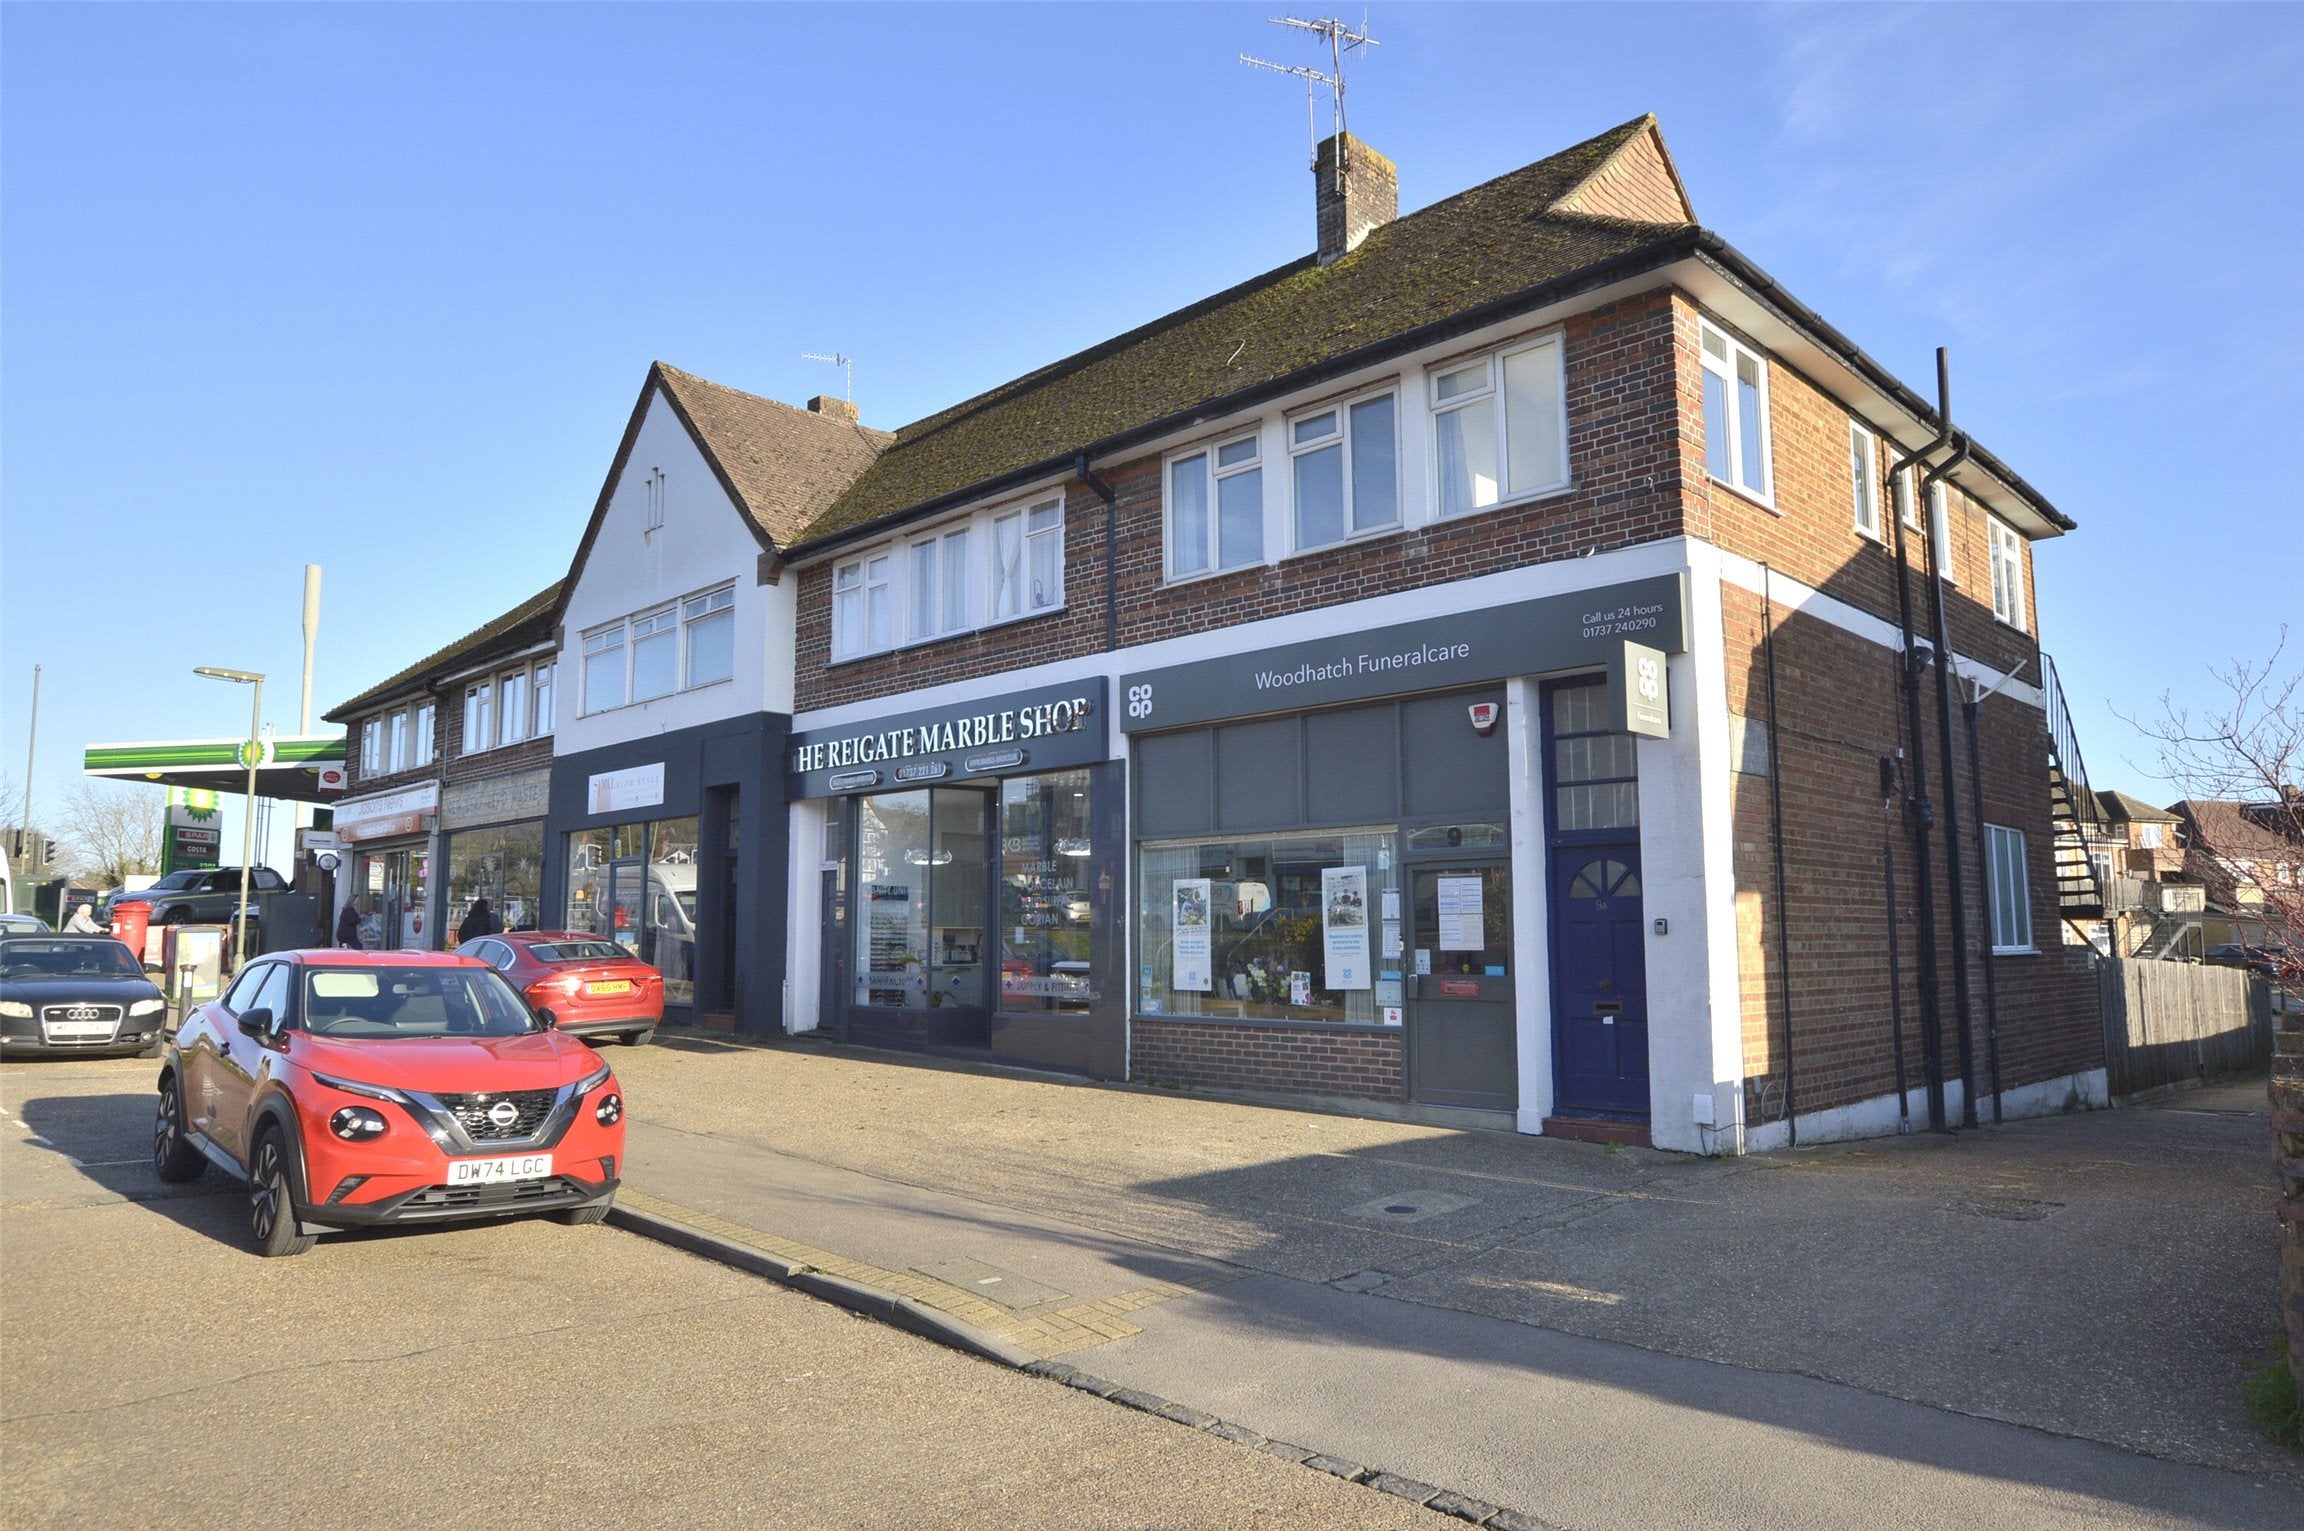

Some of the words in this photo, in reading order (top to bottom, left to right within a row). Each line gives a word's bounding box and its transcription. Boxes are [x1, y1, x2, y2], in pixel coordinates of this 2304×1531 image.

[1582, 612, 1601, 624] Call
[1604, 611, 1615, 621] us
[1618, 607, 1630, 619] 24
[1634, 604, 1663, 616] hours
[1583, 624, 1612, 639] 01737
[1615, 617, 1656, 634] 240290
[1255, 657, 1352, 690] Woodhatch
[1358, 643, 1470, 674] Funeralcare
[828, 728, 914, 768] REIGATE
[920, 711, 1014, 754] MARBLE
[1020, 698, 1091, 739] SHOP
[185, 831, 209, 841] SPAR
[186, 845, 207, 854] COSTA
[1022, 860, 1057, 873] MARBLE
[1021, 913, 1059, 925] CORIAN
[458, 1161, 505, 1180] DW74
[511, 1157, 544, 1176] LGC
